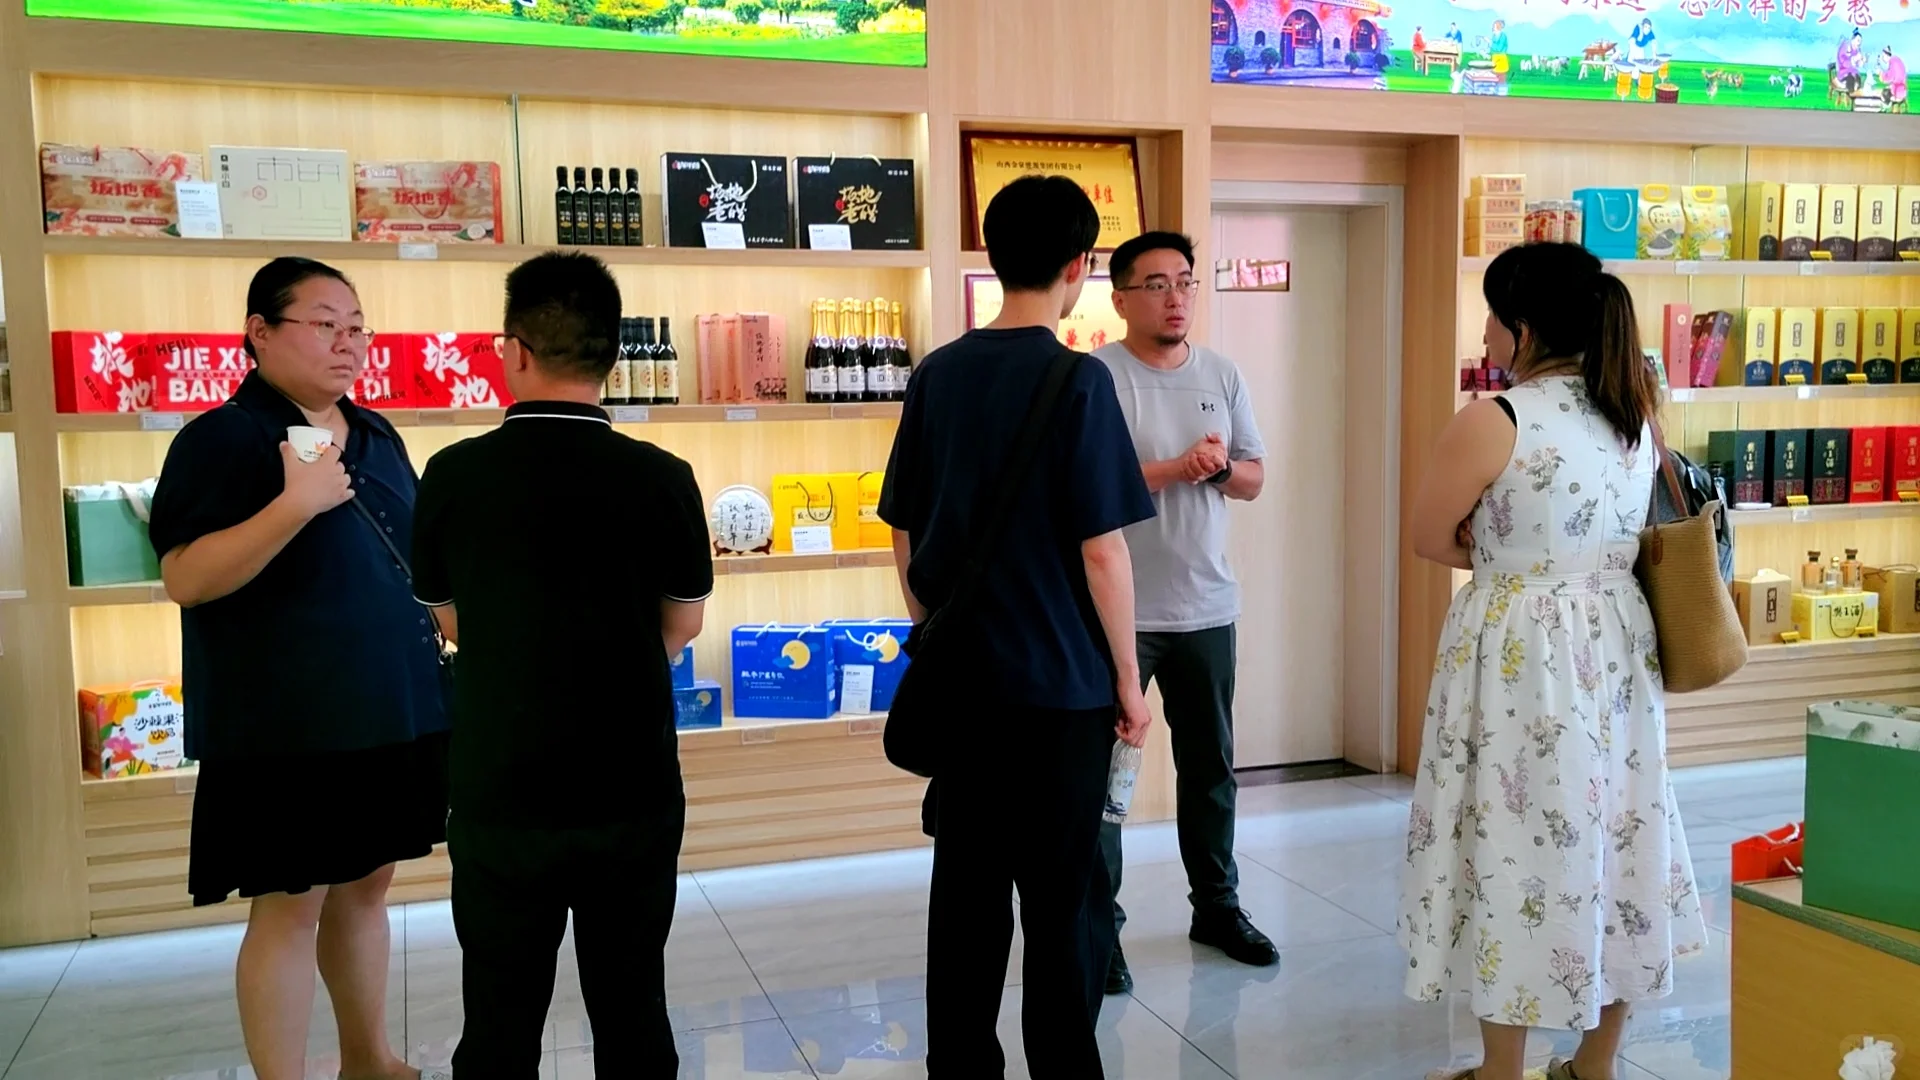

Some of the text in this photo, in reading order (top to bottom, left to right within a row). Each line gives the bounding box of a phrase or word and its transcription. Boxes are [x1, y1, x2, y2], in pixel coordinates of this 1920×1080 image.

[163, 347, 258, 370] JIE XI
[168, 377, 230, 402] BAN
